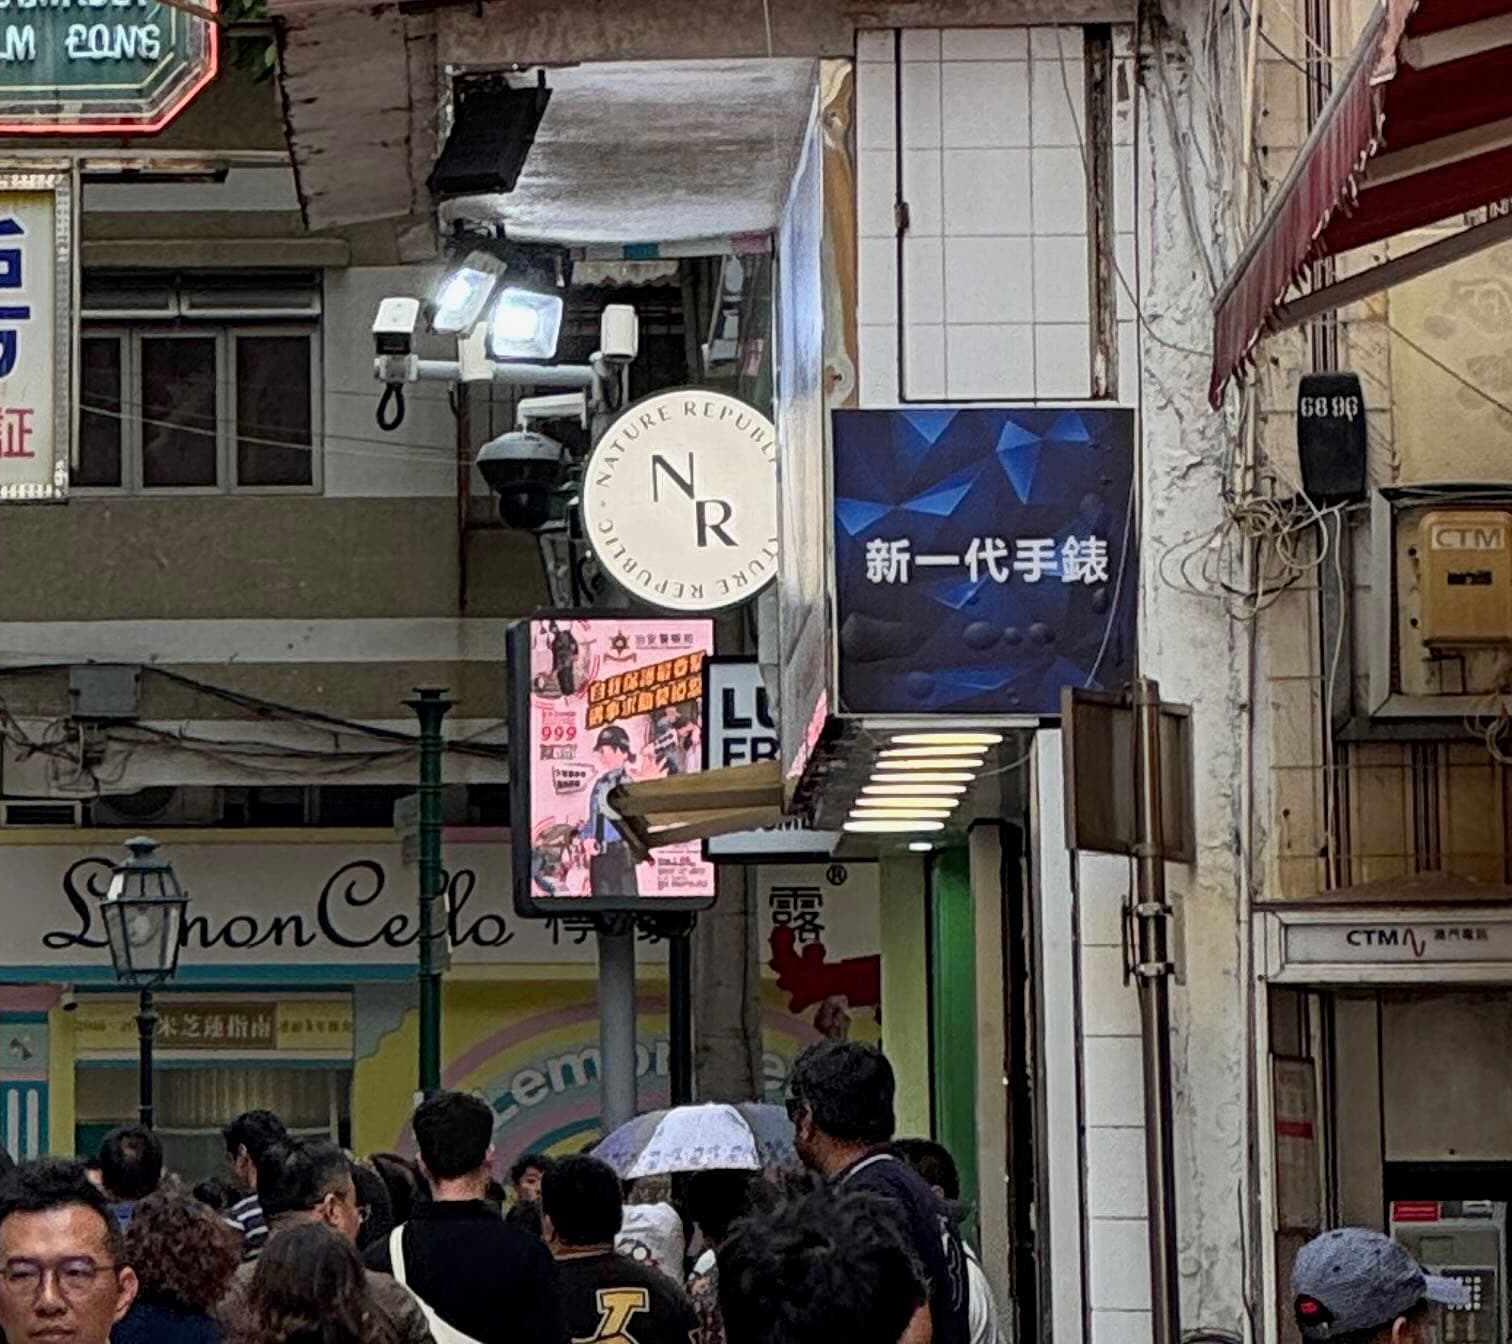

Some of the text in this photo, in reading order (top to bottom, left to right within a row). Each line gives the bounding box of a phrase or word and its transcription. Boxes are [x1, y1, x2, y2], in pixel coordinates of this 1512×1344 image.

[596, 404, 672, 489] NATURE
[1436, 527, 1502, 548] CTM
[865, 535, 1109, 585] 新一代手錶
[541, 725, 578, 743] 999
[42, 856, 515, 949] LmonCelo
[1345, 928, 1399, 947] CTM
